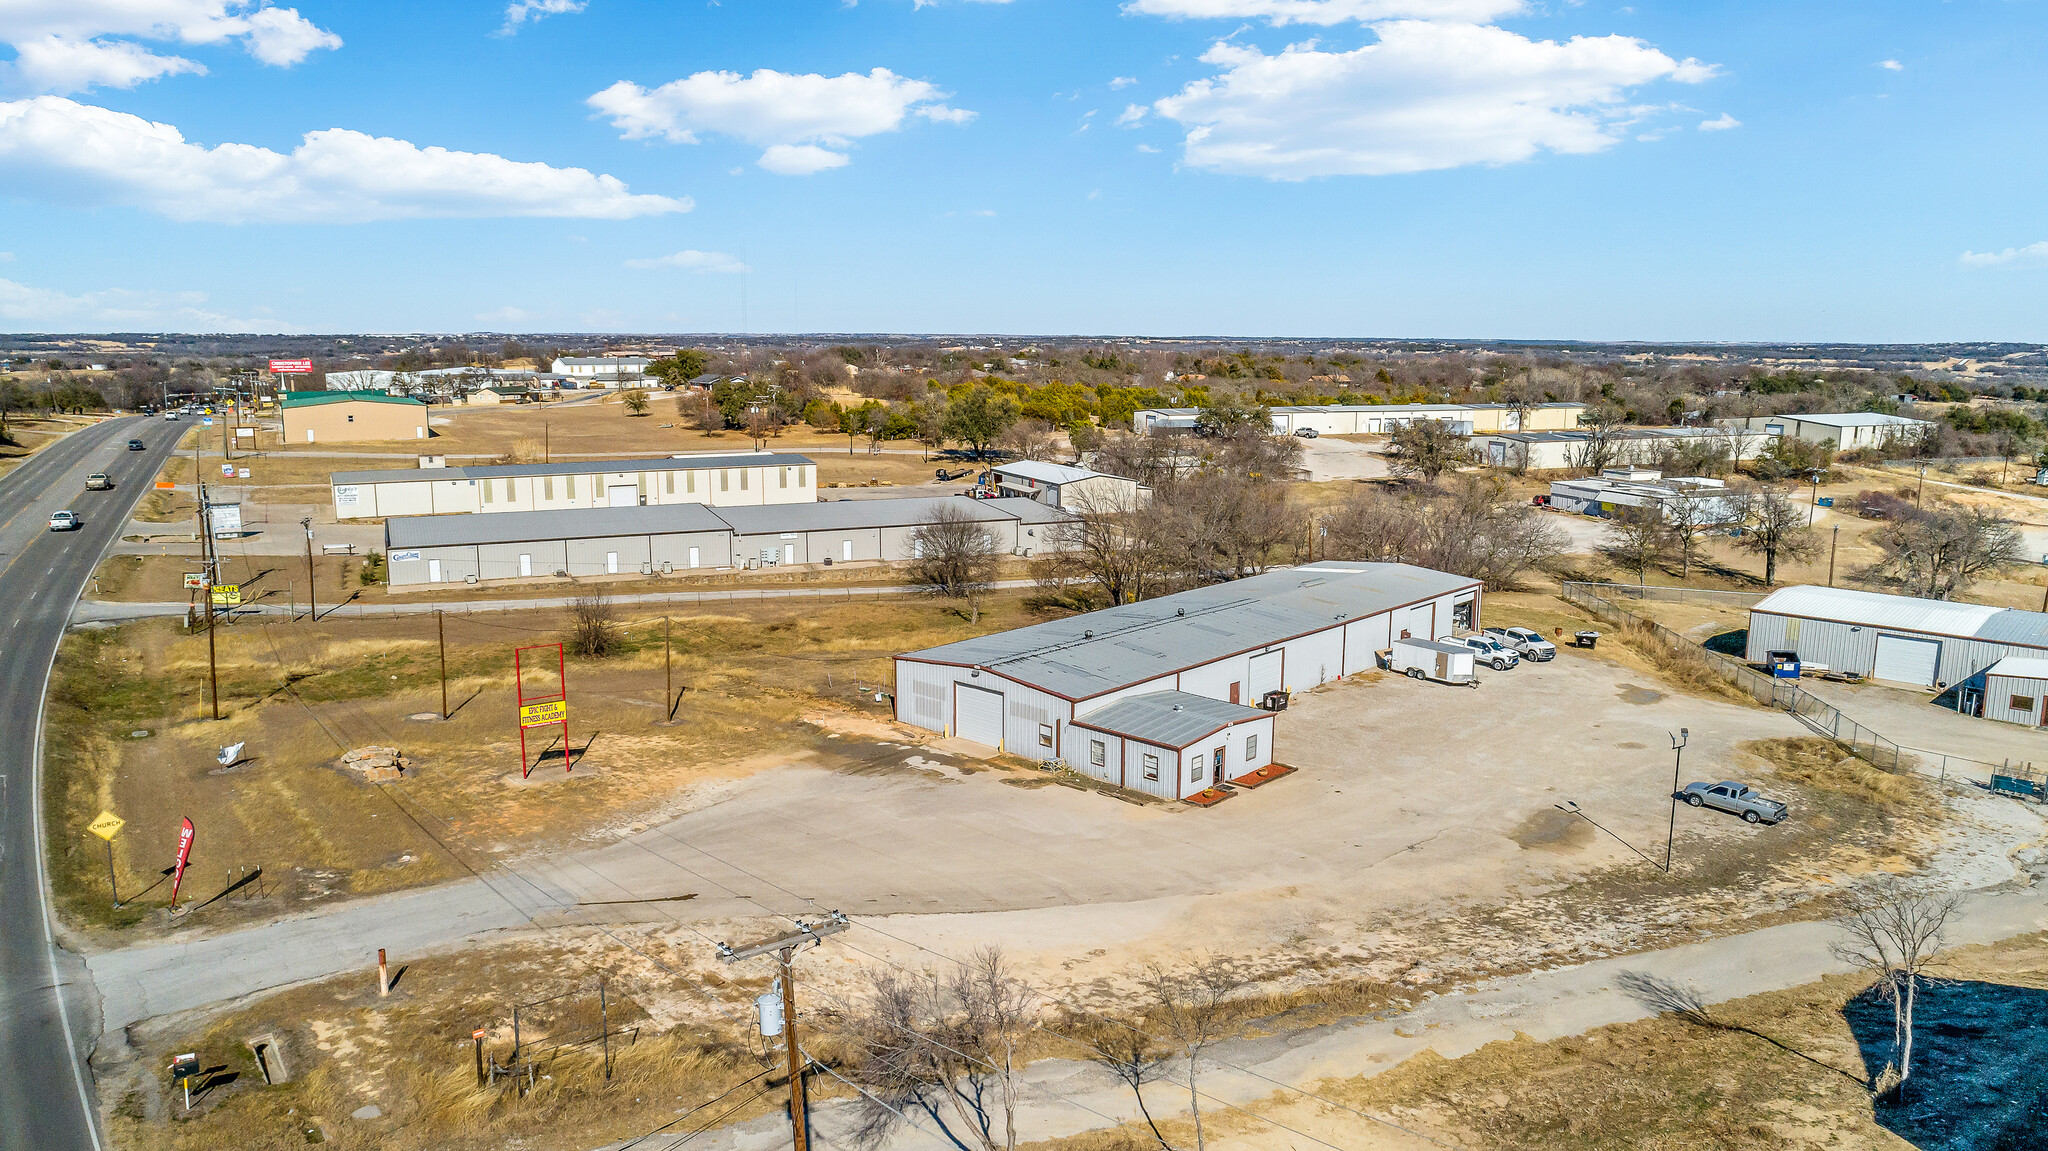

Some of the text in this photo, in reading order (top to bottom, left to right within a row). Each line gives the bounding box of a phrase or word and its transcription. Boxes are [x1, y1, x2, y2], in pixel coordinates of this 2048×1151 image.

[213, 584, 239, 593] MEATS
[528, 706, 539, 714] EPIC
[540, 704, 554, 713] FIGHT
[522, 714, 541, 724] FITNESS
[541, 711, 565, 721] ACADEMY
[92, 820, 121, 830] CHURCH
